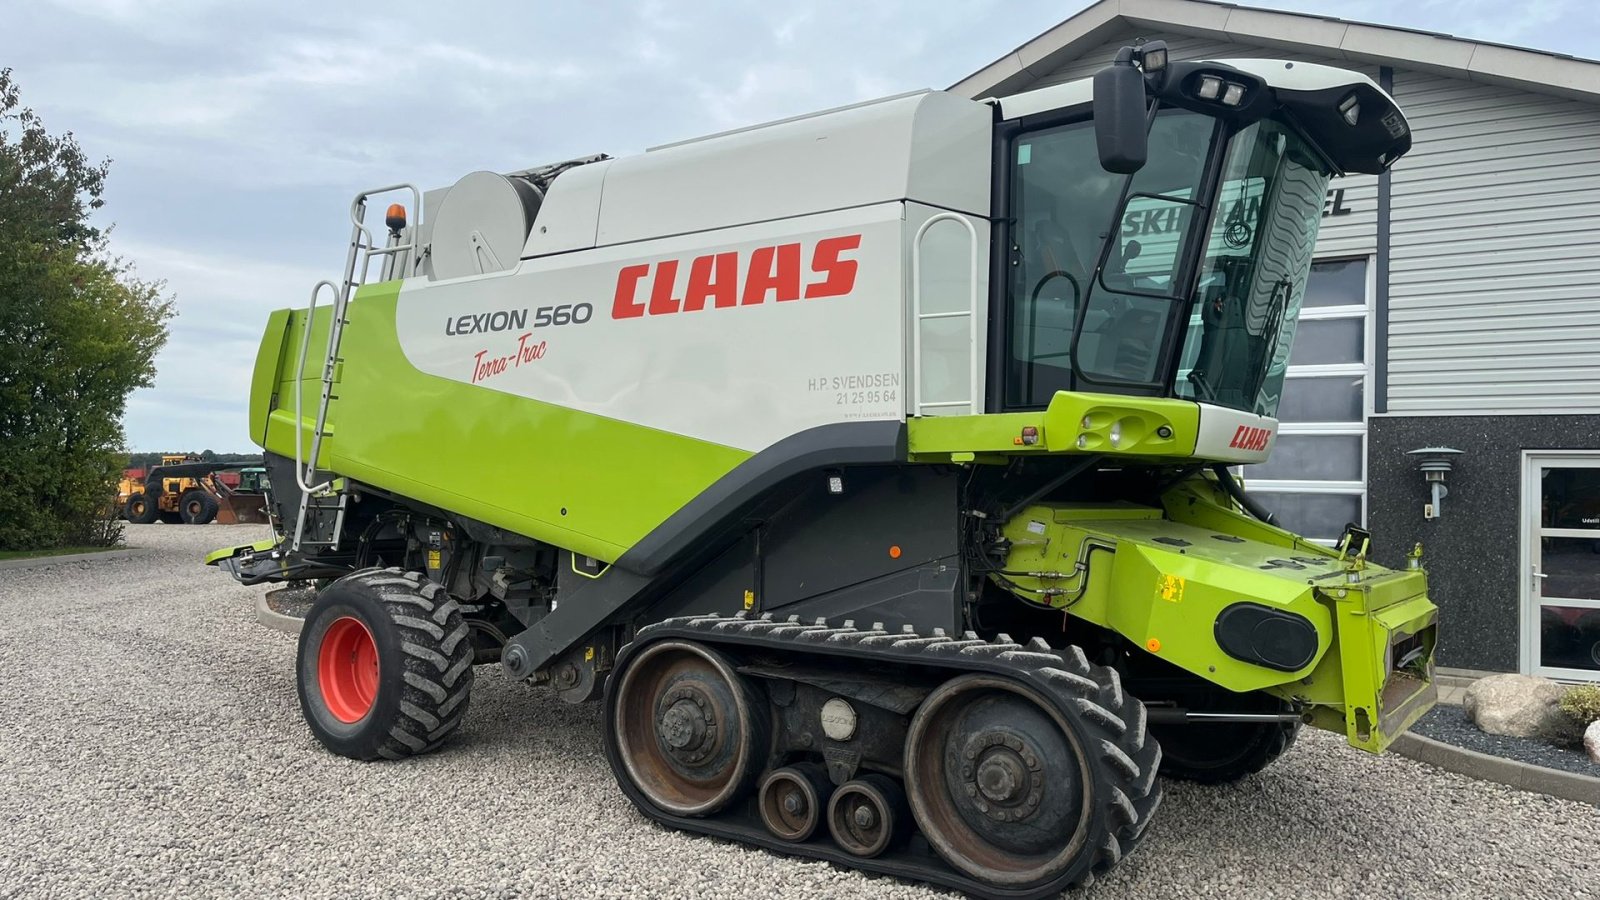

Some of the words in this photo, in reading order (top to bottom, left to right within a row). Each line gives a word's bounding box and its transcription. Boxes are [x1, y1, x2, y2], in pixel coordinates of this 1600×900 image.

[611, 234, 862, 320] CLAAS
[445, 308, 528, 337] LEXION
[533, 302, 594, 328] 560
[471, 332, 547, 384] Terra-Trac
[832, 372, 900, 390] SVENDSEN
[836, 392, 848, 405] 21
[851, 391, 865, 404] 25
[867, 390, 880, 404] 95
[883, 389, 896, 403] 64
[1229, 424, 1272, 452] CLAAS
